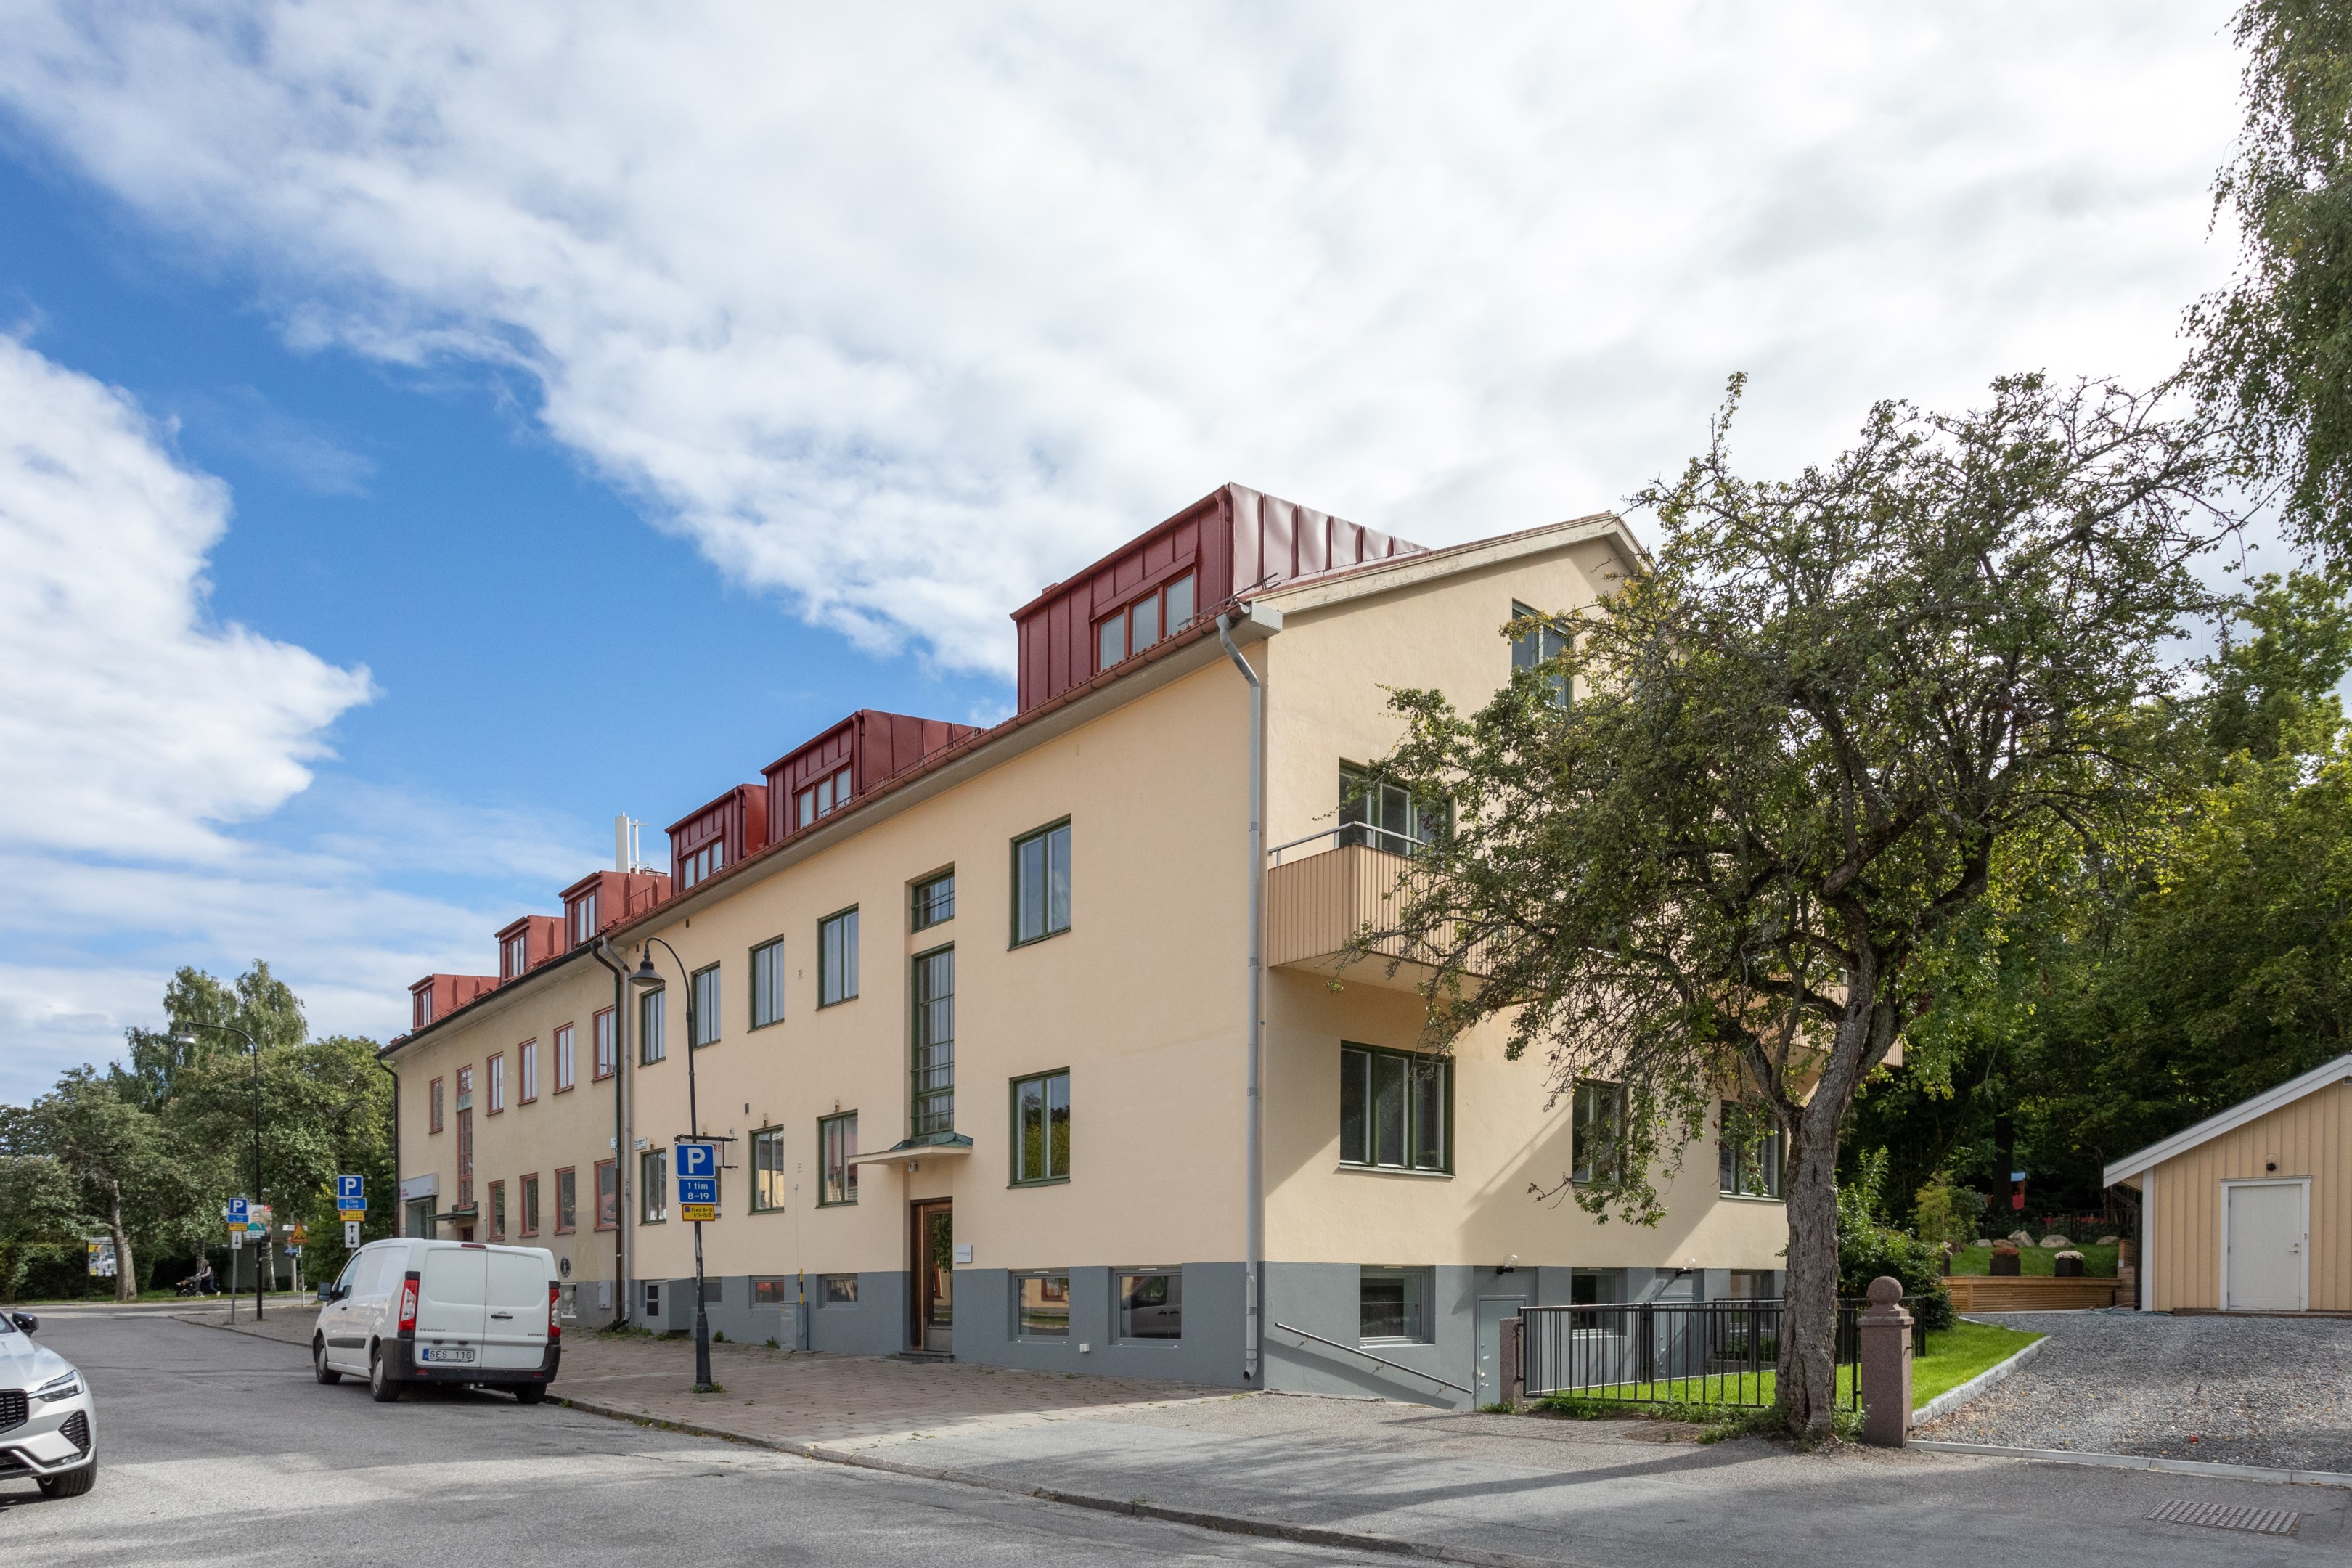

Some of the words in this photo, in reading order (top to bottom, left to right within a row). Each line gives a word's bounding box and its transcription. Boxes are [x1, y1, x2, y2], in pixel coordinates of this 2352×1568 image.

[687, 1147, 706, 1174] P
[345, 1177, 357, 1196] P
[232, 1199, 244, 1213] P
[430, 1350, 448, 1359] SES
[456, 1351, 472, 1360] 116
